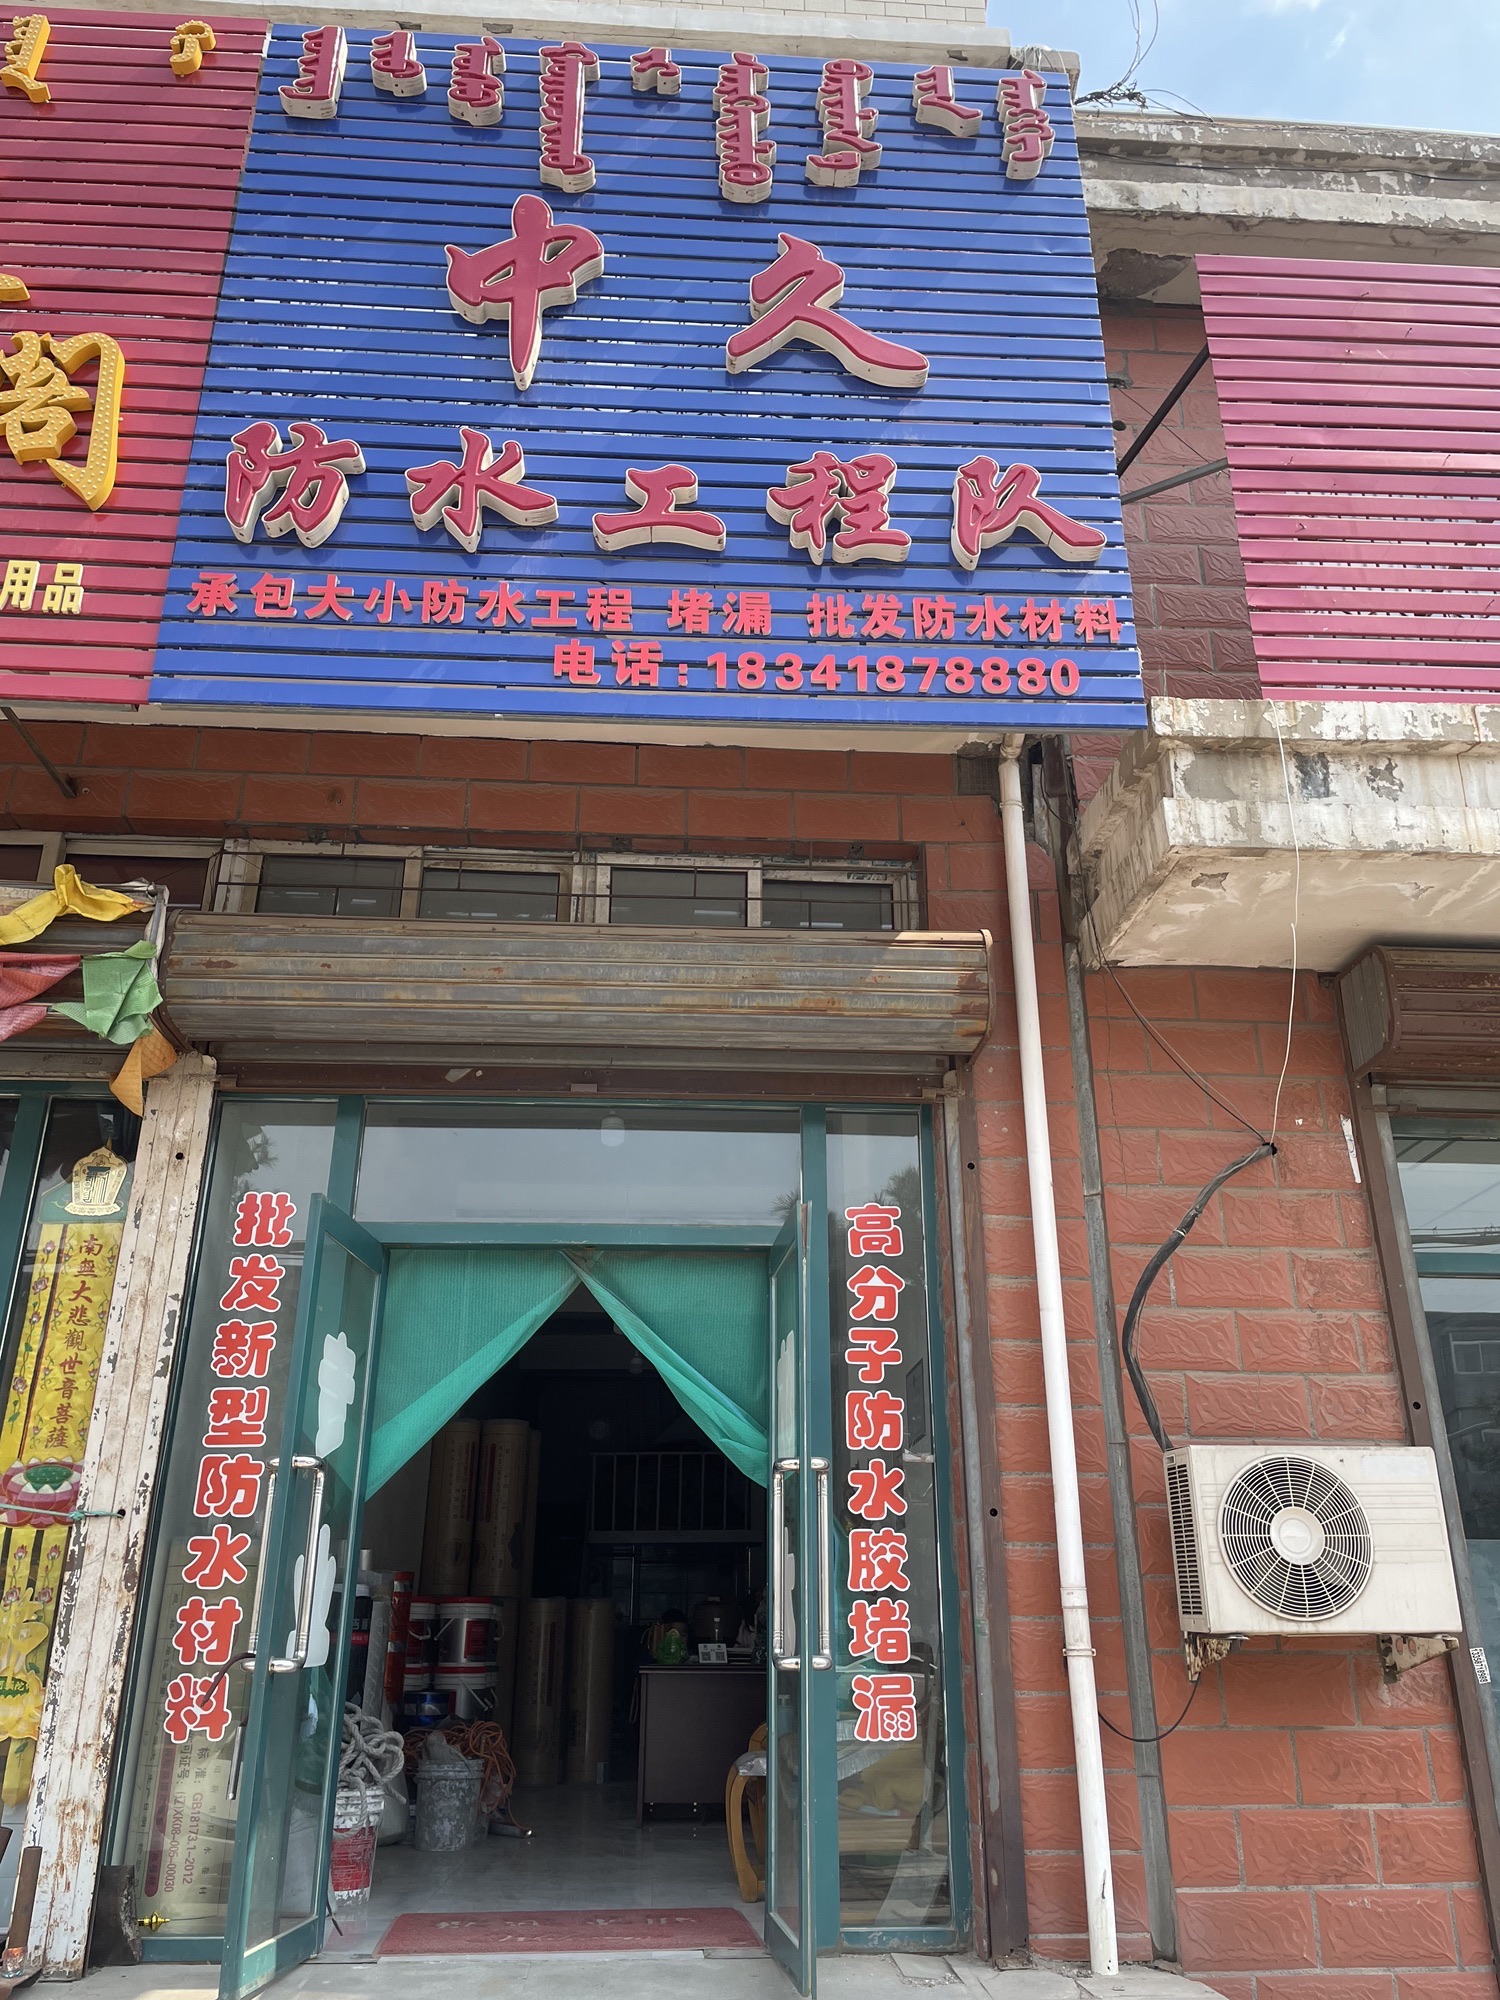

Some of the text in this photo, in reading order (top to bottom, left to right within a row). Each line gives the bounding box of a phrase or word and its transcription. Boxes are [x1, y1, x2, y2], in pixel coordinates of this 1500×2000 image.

[445, 194, 930, 391] 中久
[0, 559, 84, 615] 用品
[225, 421, 1107, 571] 防水工程队
[187, 572, 1122, 645] 承包大小防水工程 堵漏 批发防水材料
[44, 1233, 104, 1449] 南無大悲觀世音菩薩
[165, 1191, 297, 1744] 批发新型防水材料
[843, 1202, 918, 1742] 高分子防水胶堵漏
